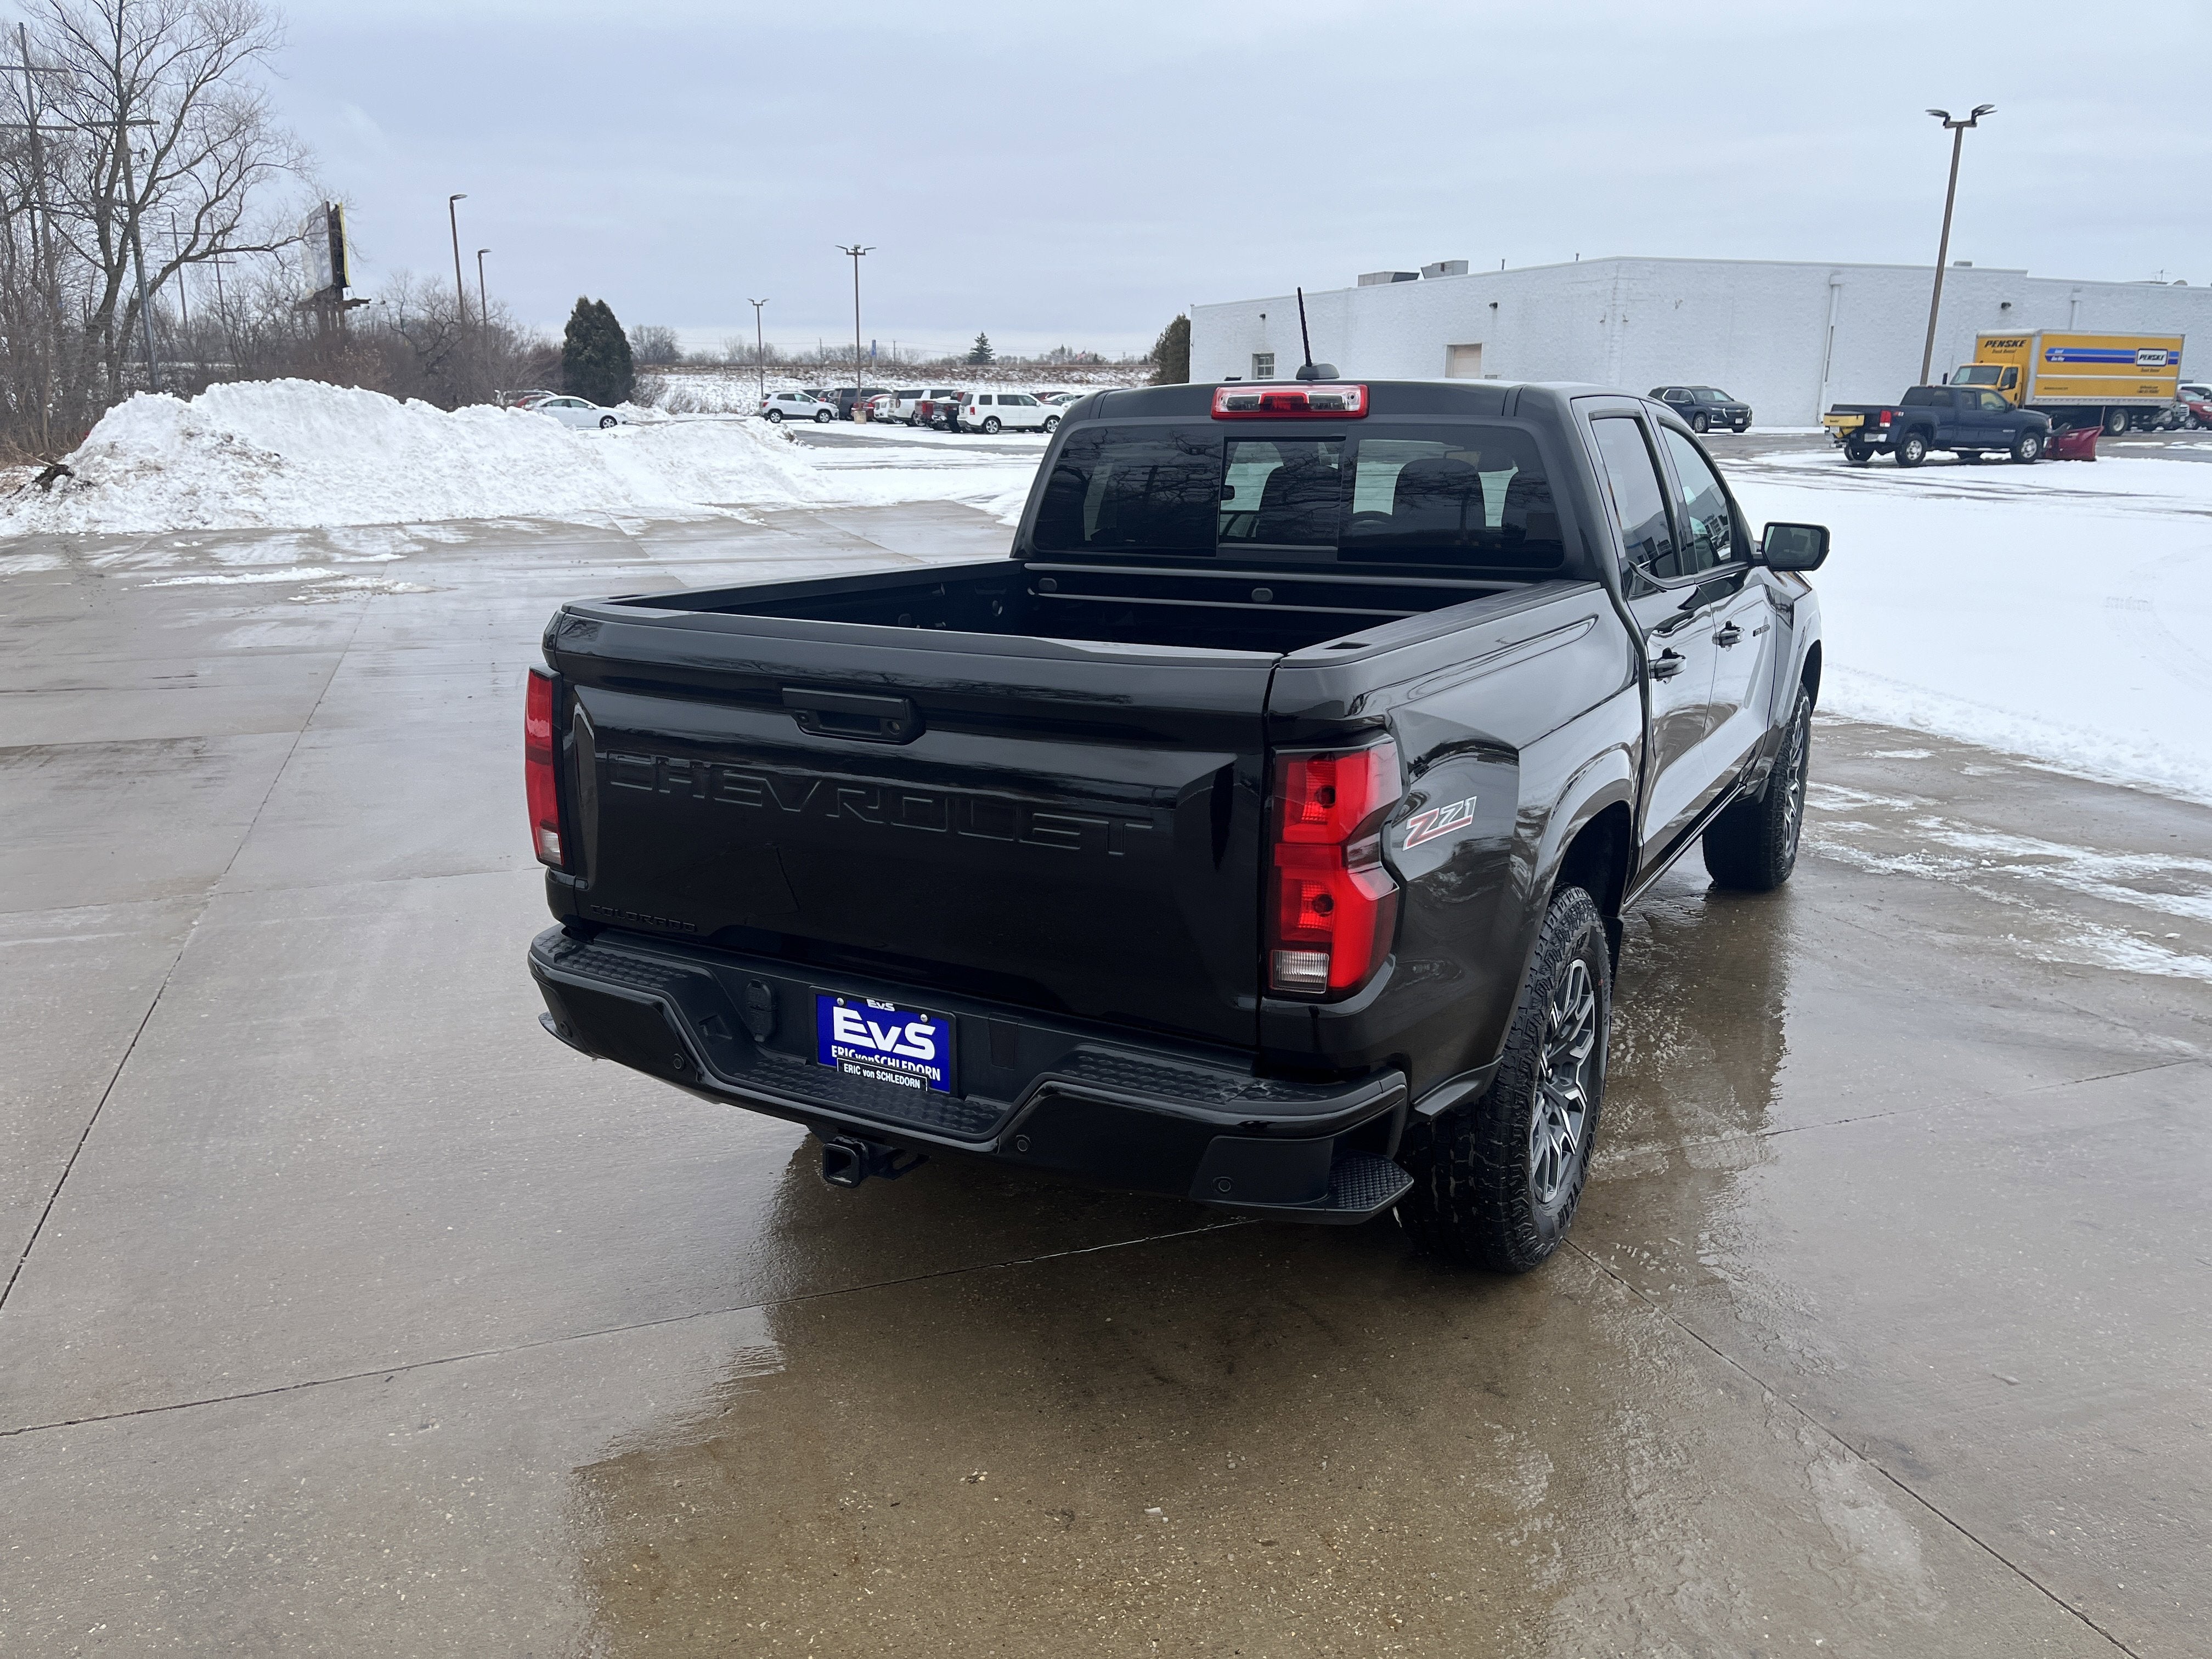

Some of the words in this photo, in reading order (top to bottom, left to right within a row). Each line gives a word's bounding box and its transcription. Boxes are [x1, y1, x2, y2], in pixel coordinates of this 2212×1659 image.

[1984, 340, 2027, 348] PENSKE
[606, 749, 1154, 856] CHEVROLET
[1403, 795, 1477, 851] Z71
[590, 905, 698, 932] COLORADO
[843, 1063, 861, 1075] ERIC
[862, 1069, 874, 1079] von
[876, 1070, 921, 1089] SCHLEDORN
